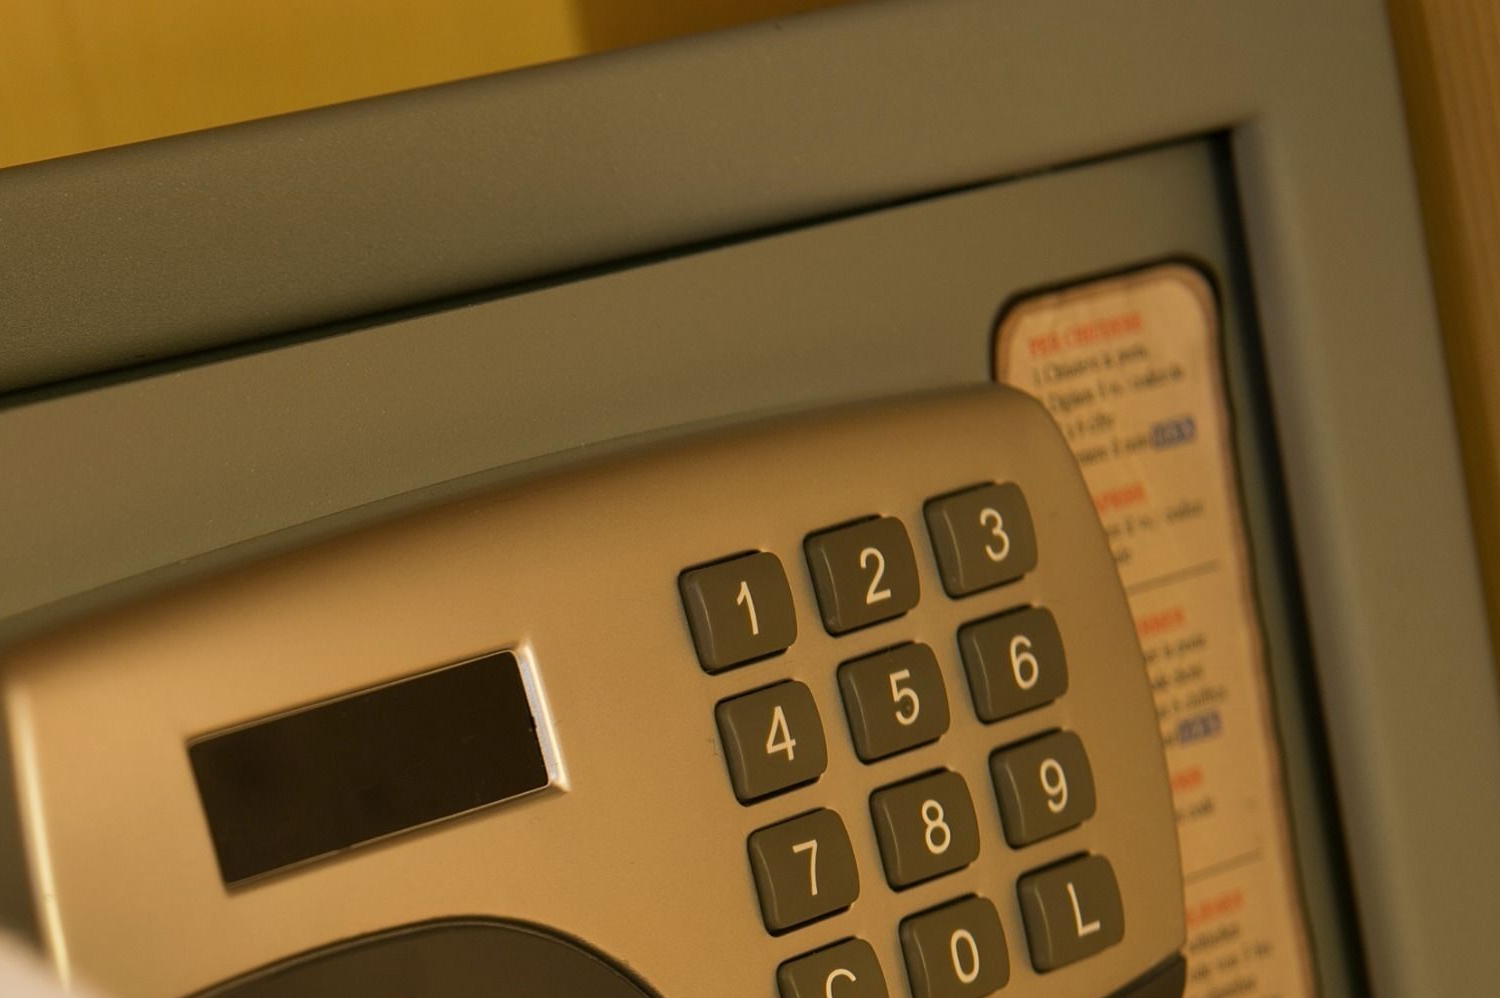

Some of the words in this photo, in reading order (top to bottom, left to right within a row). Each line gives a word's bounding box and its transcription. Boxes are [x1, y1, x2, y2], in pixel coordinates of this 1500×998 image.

[737, 581, 758, 635] 1
[860, 548, 891, 604] 2
[980, 508, 1009, 561] 3
[766, 706, 796, 760] 4
[890, 669, 919, 725] 5
[1010, 636, 1038, 689] 6
[793, 840, 817, 895] 7
[922, 800, 950, 854] 8
[1040, 759, 1067, 812] 9
[951, 929, 979, 983] 0
[1067, 883, 1100, 936] L
